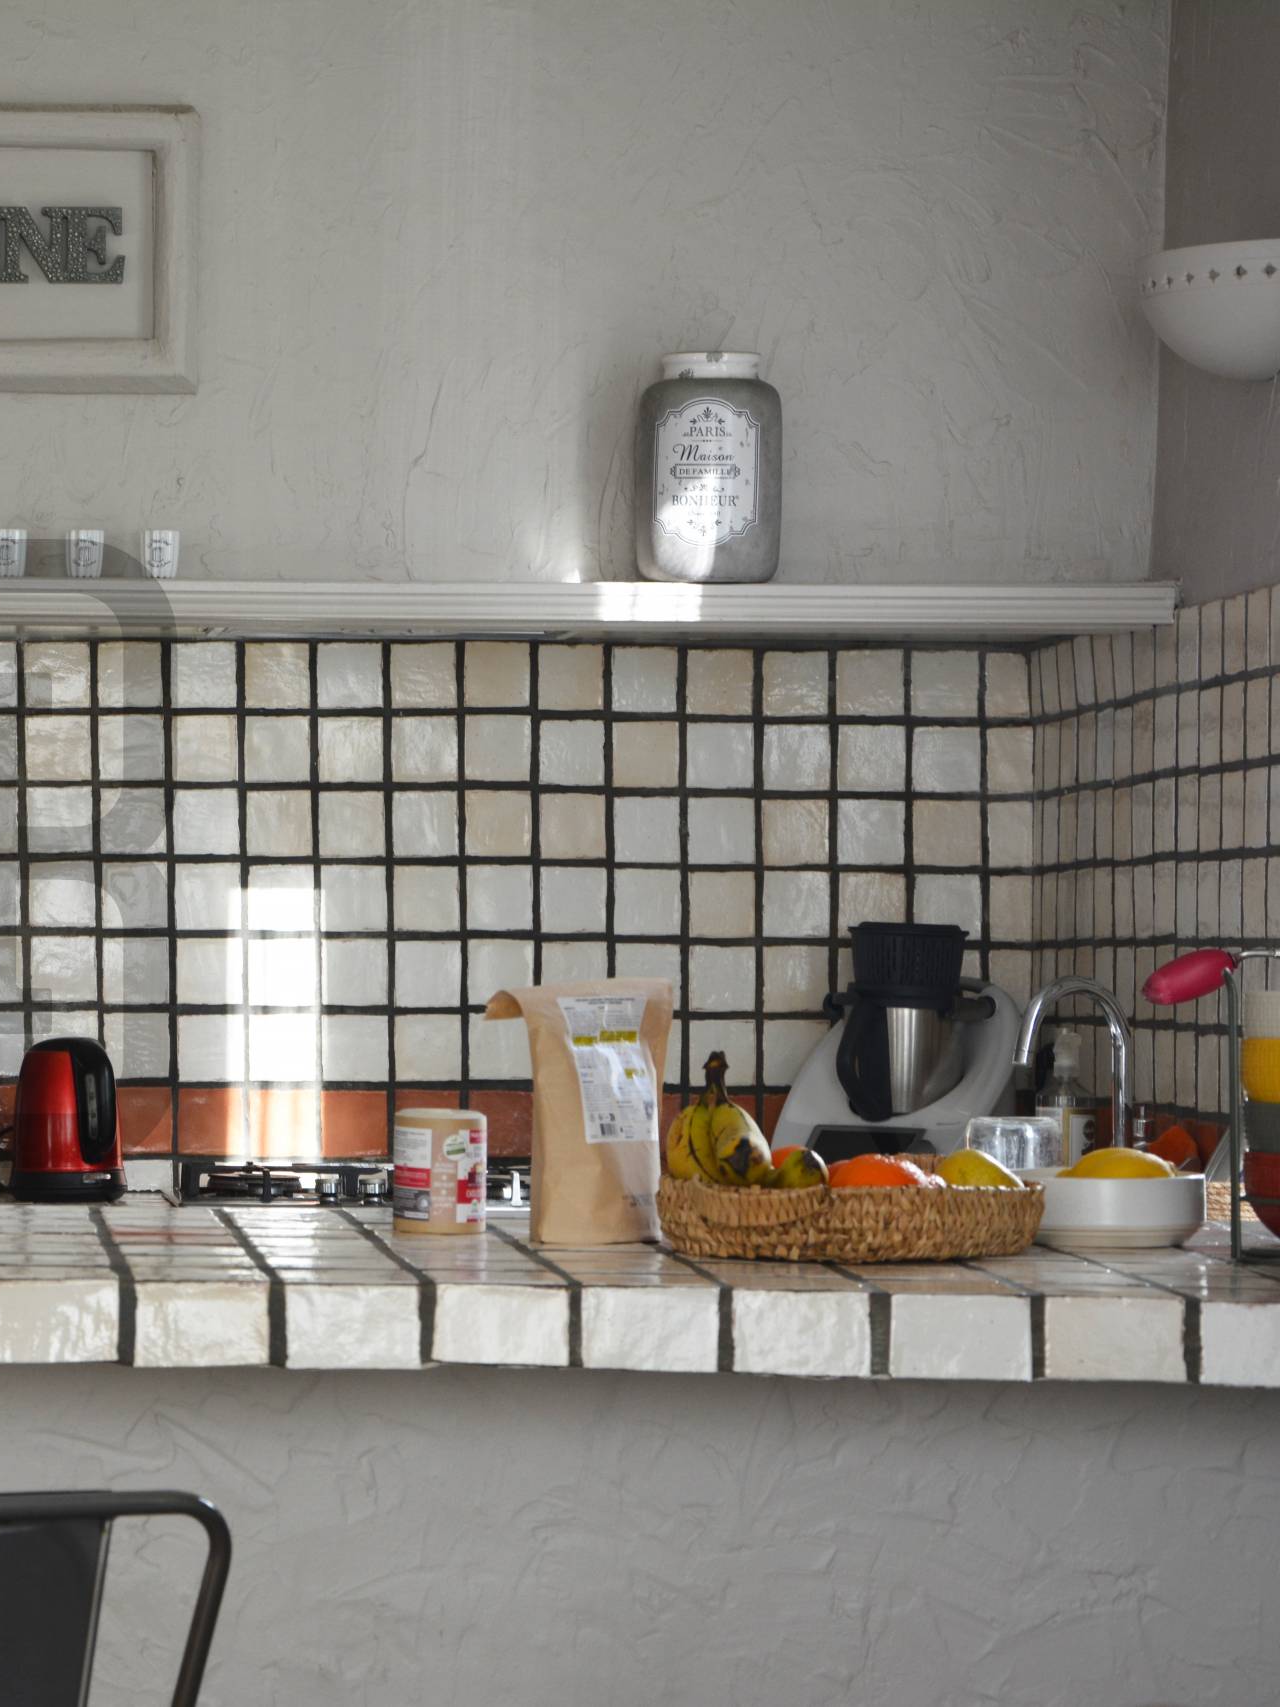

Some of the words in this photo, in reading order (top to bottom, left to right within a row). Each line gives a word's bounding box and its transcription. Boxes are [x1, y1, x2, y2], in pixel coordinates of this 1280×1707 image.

[689, 426, 726, 437] PARIS
[673, 444, 733, 462] Maison
[679, 468, 691, 476] DE
[692, 468, 732, 476] FAMILLE
[672, 495, 737, 507] BONHEUR
